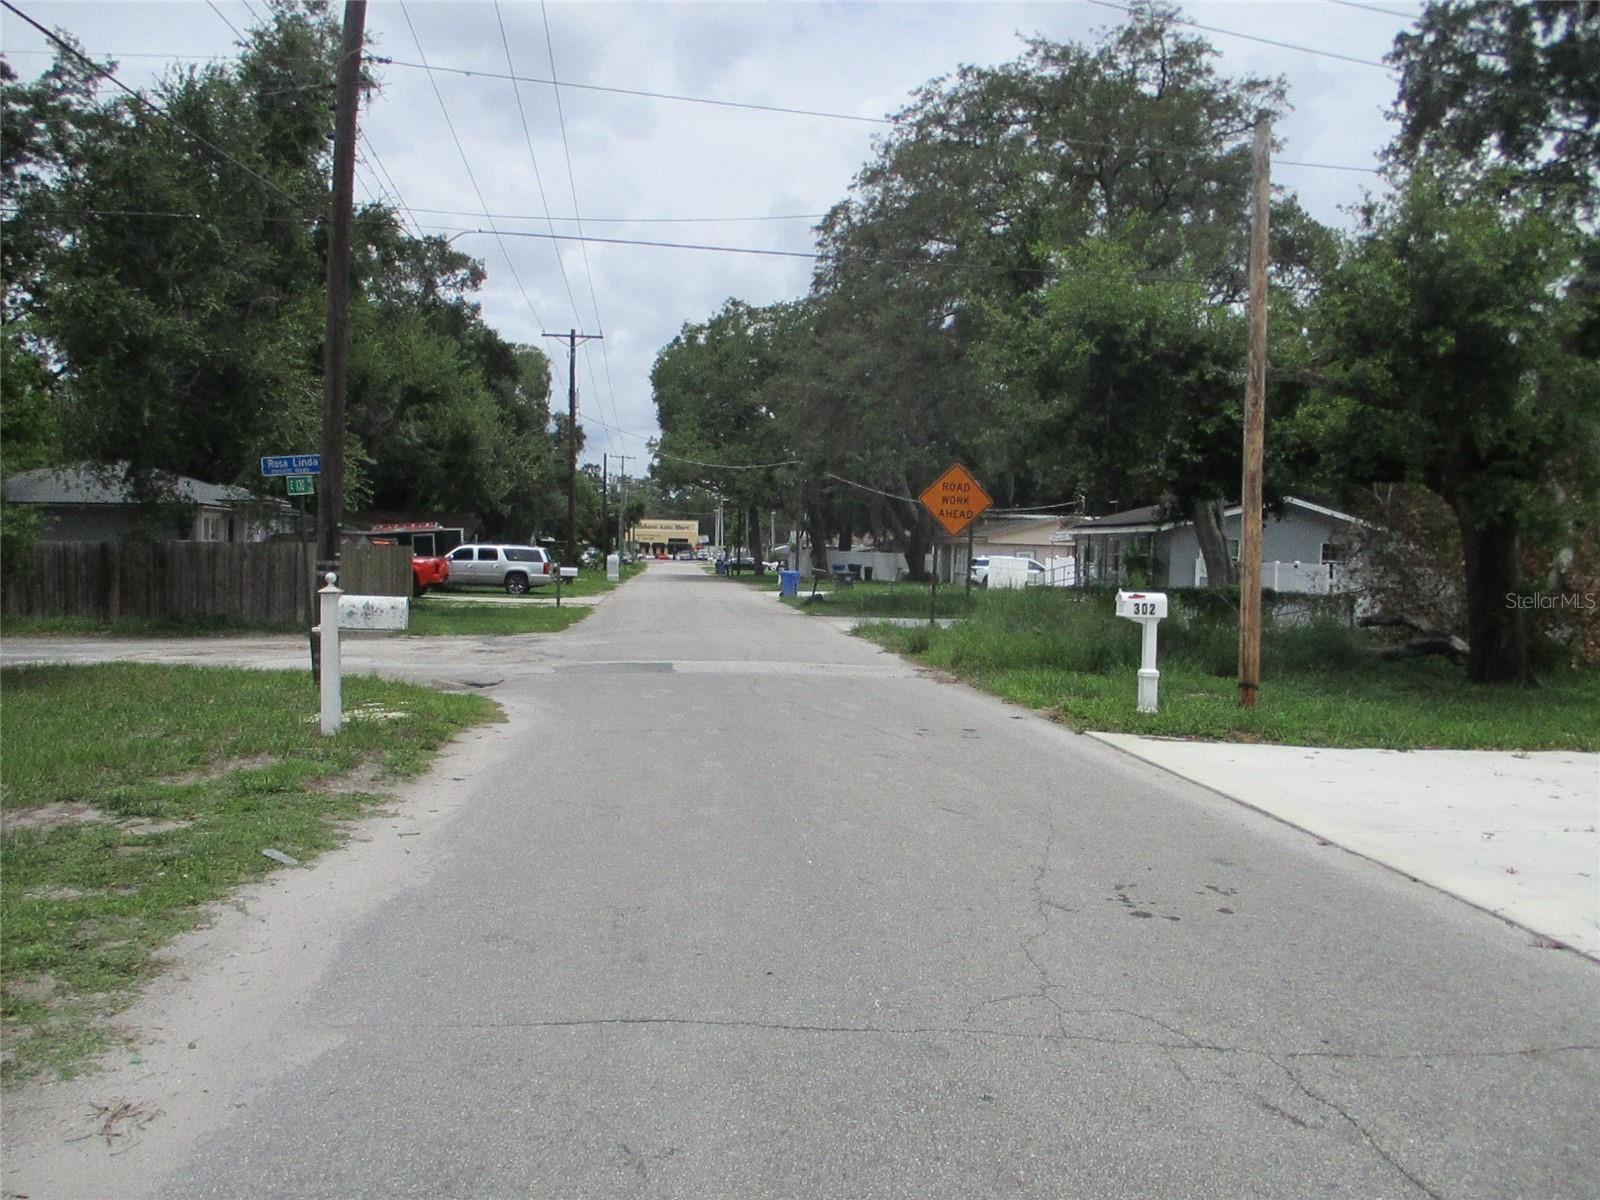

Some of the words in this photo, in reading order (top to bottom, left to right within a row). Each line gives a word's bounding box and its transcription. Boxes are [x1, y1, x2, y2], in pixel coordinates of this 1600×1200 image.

[267, 459, 288, 469] Rosa
[292, 457, 319, 467] Linda
[942, 482, 970, 493] ROAD
[941, 496, 970, 505] WORK
[939, 509, 973, 519] AHEAD
[1133, 602, 1156, 615] 302
